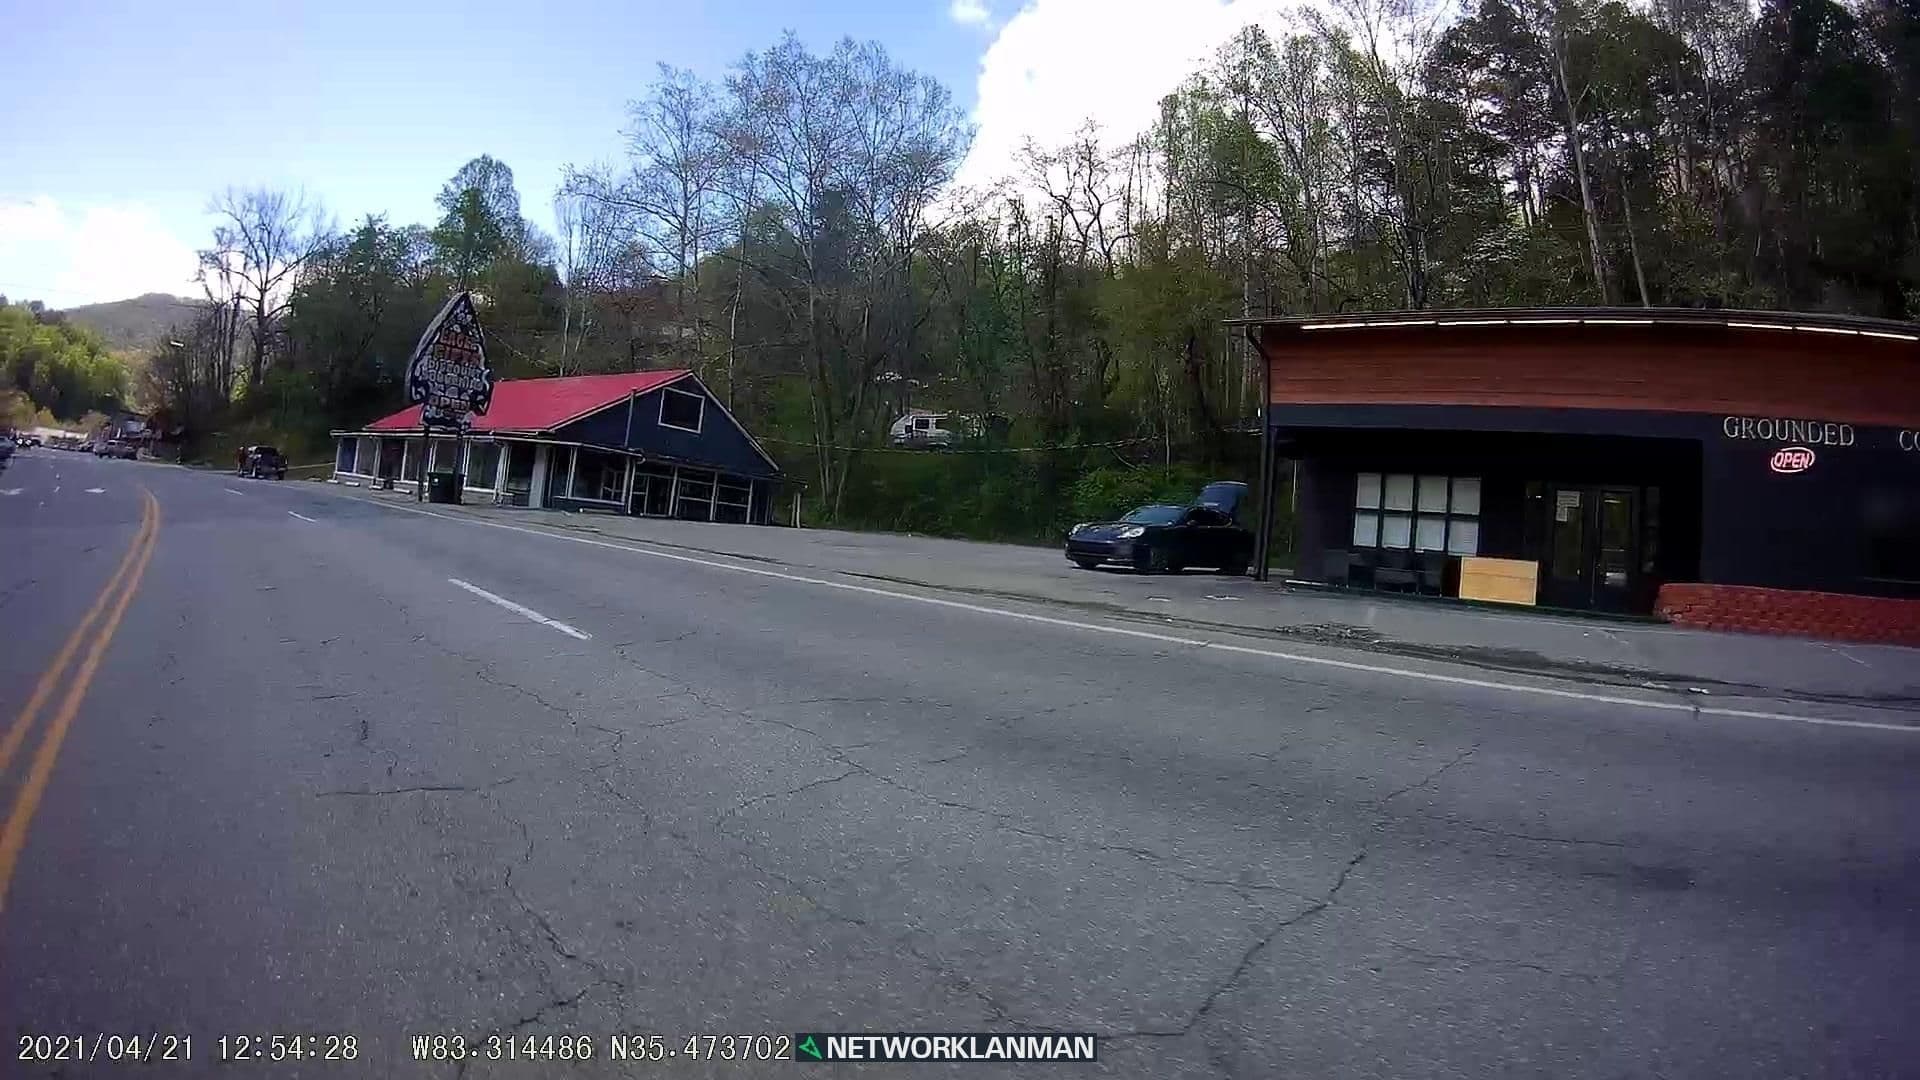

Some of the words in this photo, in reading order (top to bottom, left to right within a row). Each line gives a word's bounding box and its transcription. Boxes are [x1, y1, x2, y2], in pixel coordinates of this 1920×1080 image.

[429, 395, 471, 411] OPEN
[1723, 416, 1854, 446] GROUNDED
[1774, 451, 1810, 469] OPEN
